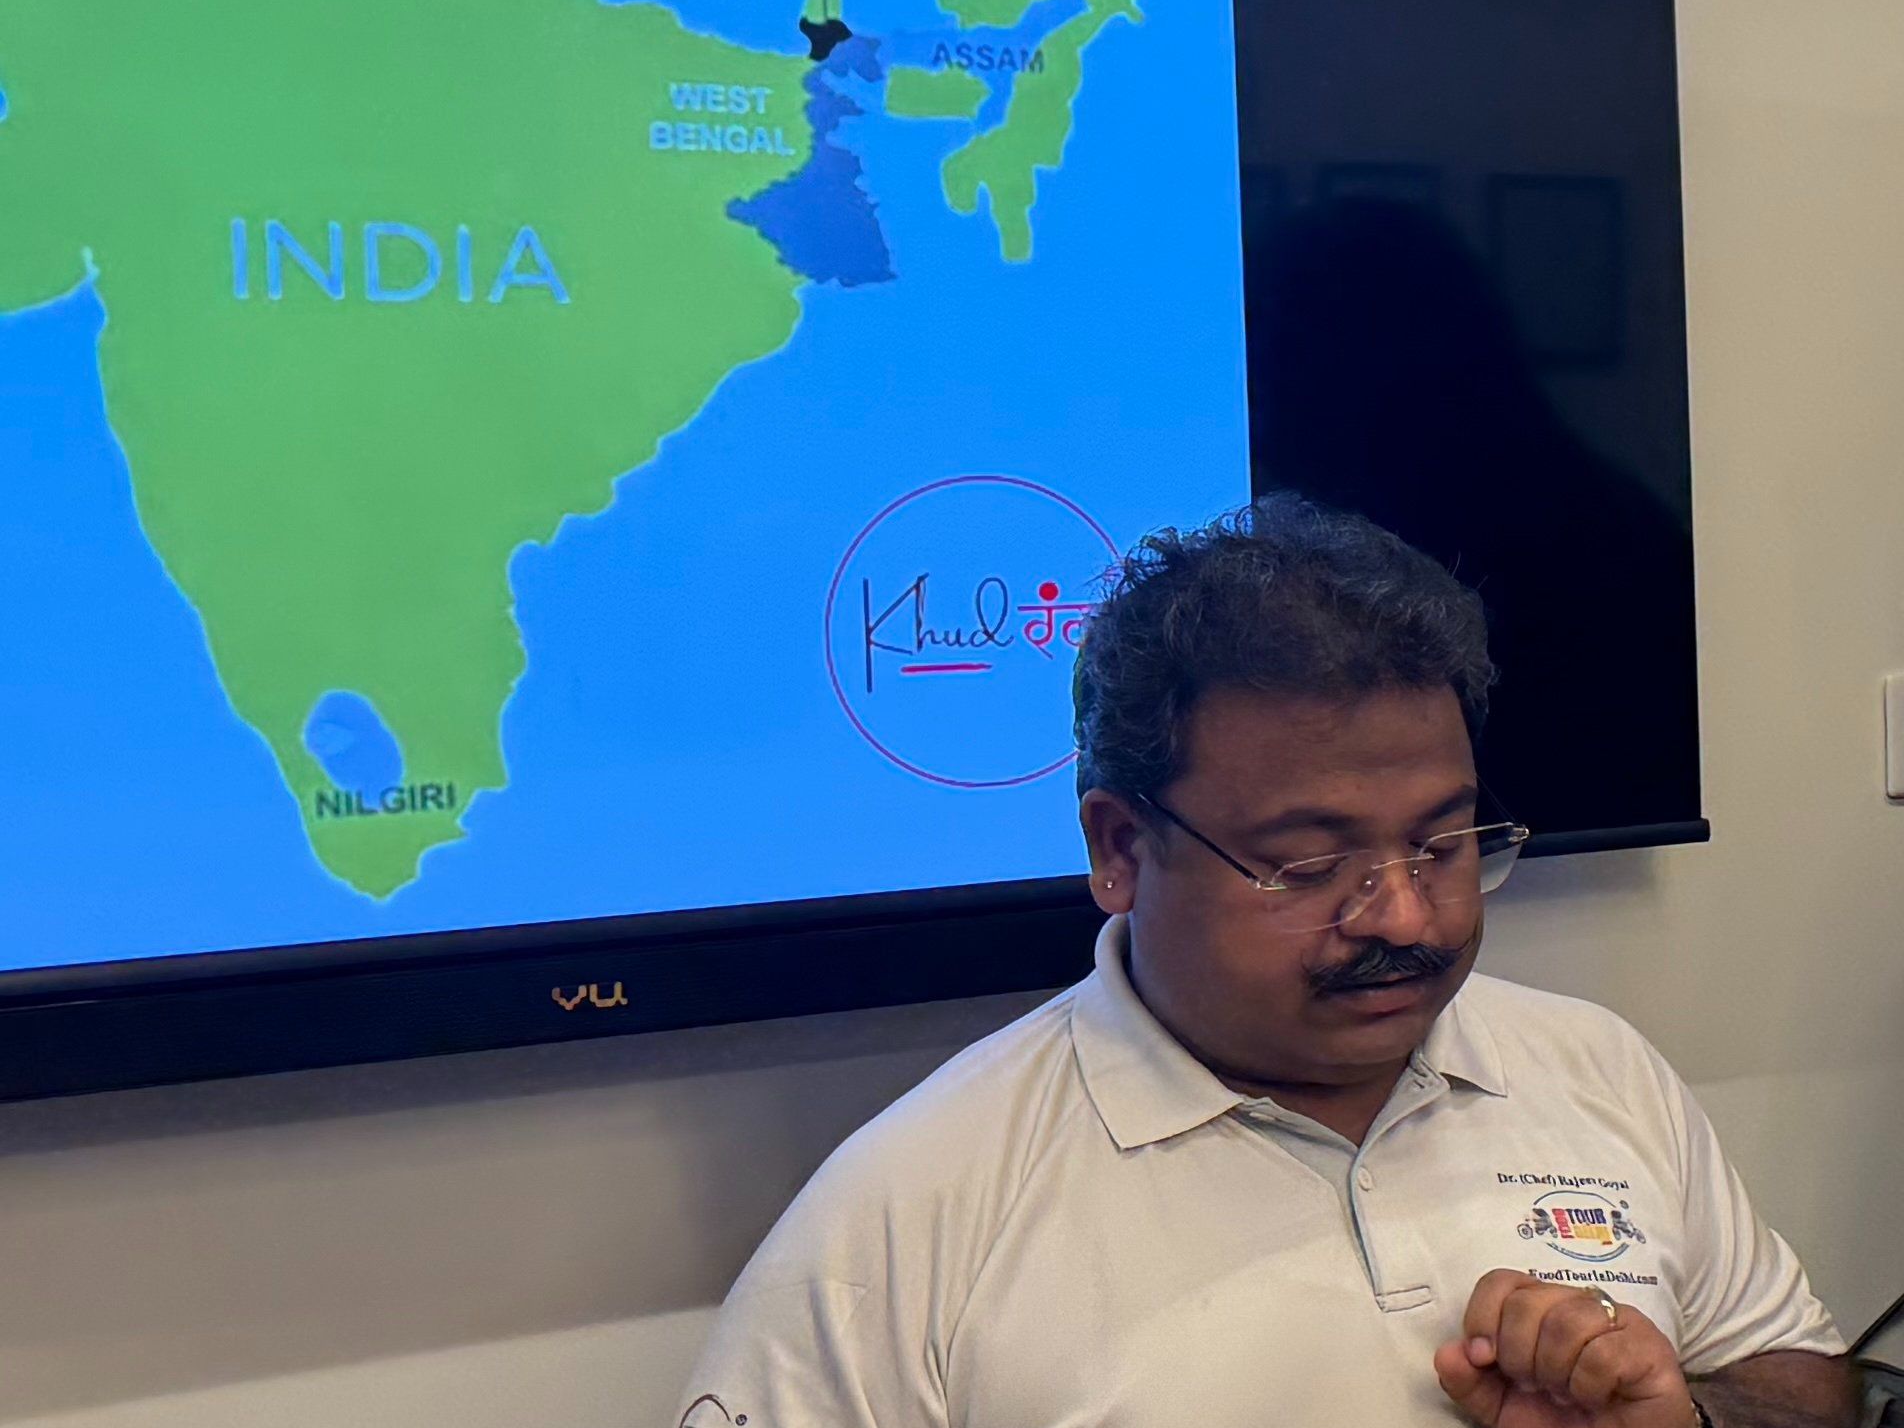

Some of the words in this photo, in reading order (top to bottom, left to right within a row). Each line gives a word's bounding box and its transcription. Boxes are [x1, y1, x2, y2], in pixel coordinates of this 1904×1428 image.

[932, 42, 1045, 74] ASSAM
[669, 82, 773, 115] WEST
[649, 121, 796, 156] BENGAL
[231, 217, 571, 303] INDIA
[862, 572, 1015, 694] Khud
[315, 781, 456, 819] NILGIRI
[1497, 1173, 1517, 1184] Dr.
[1565, 1208, 1607, 1224] TOUR
